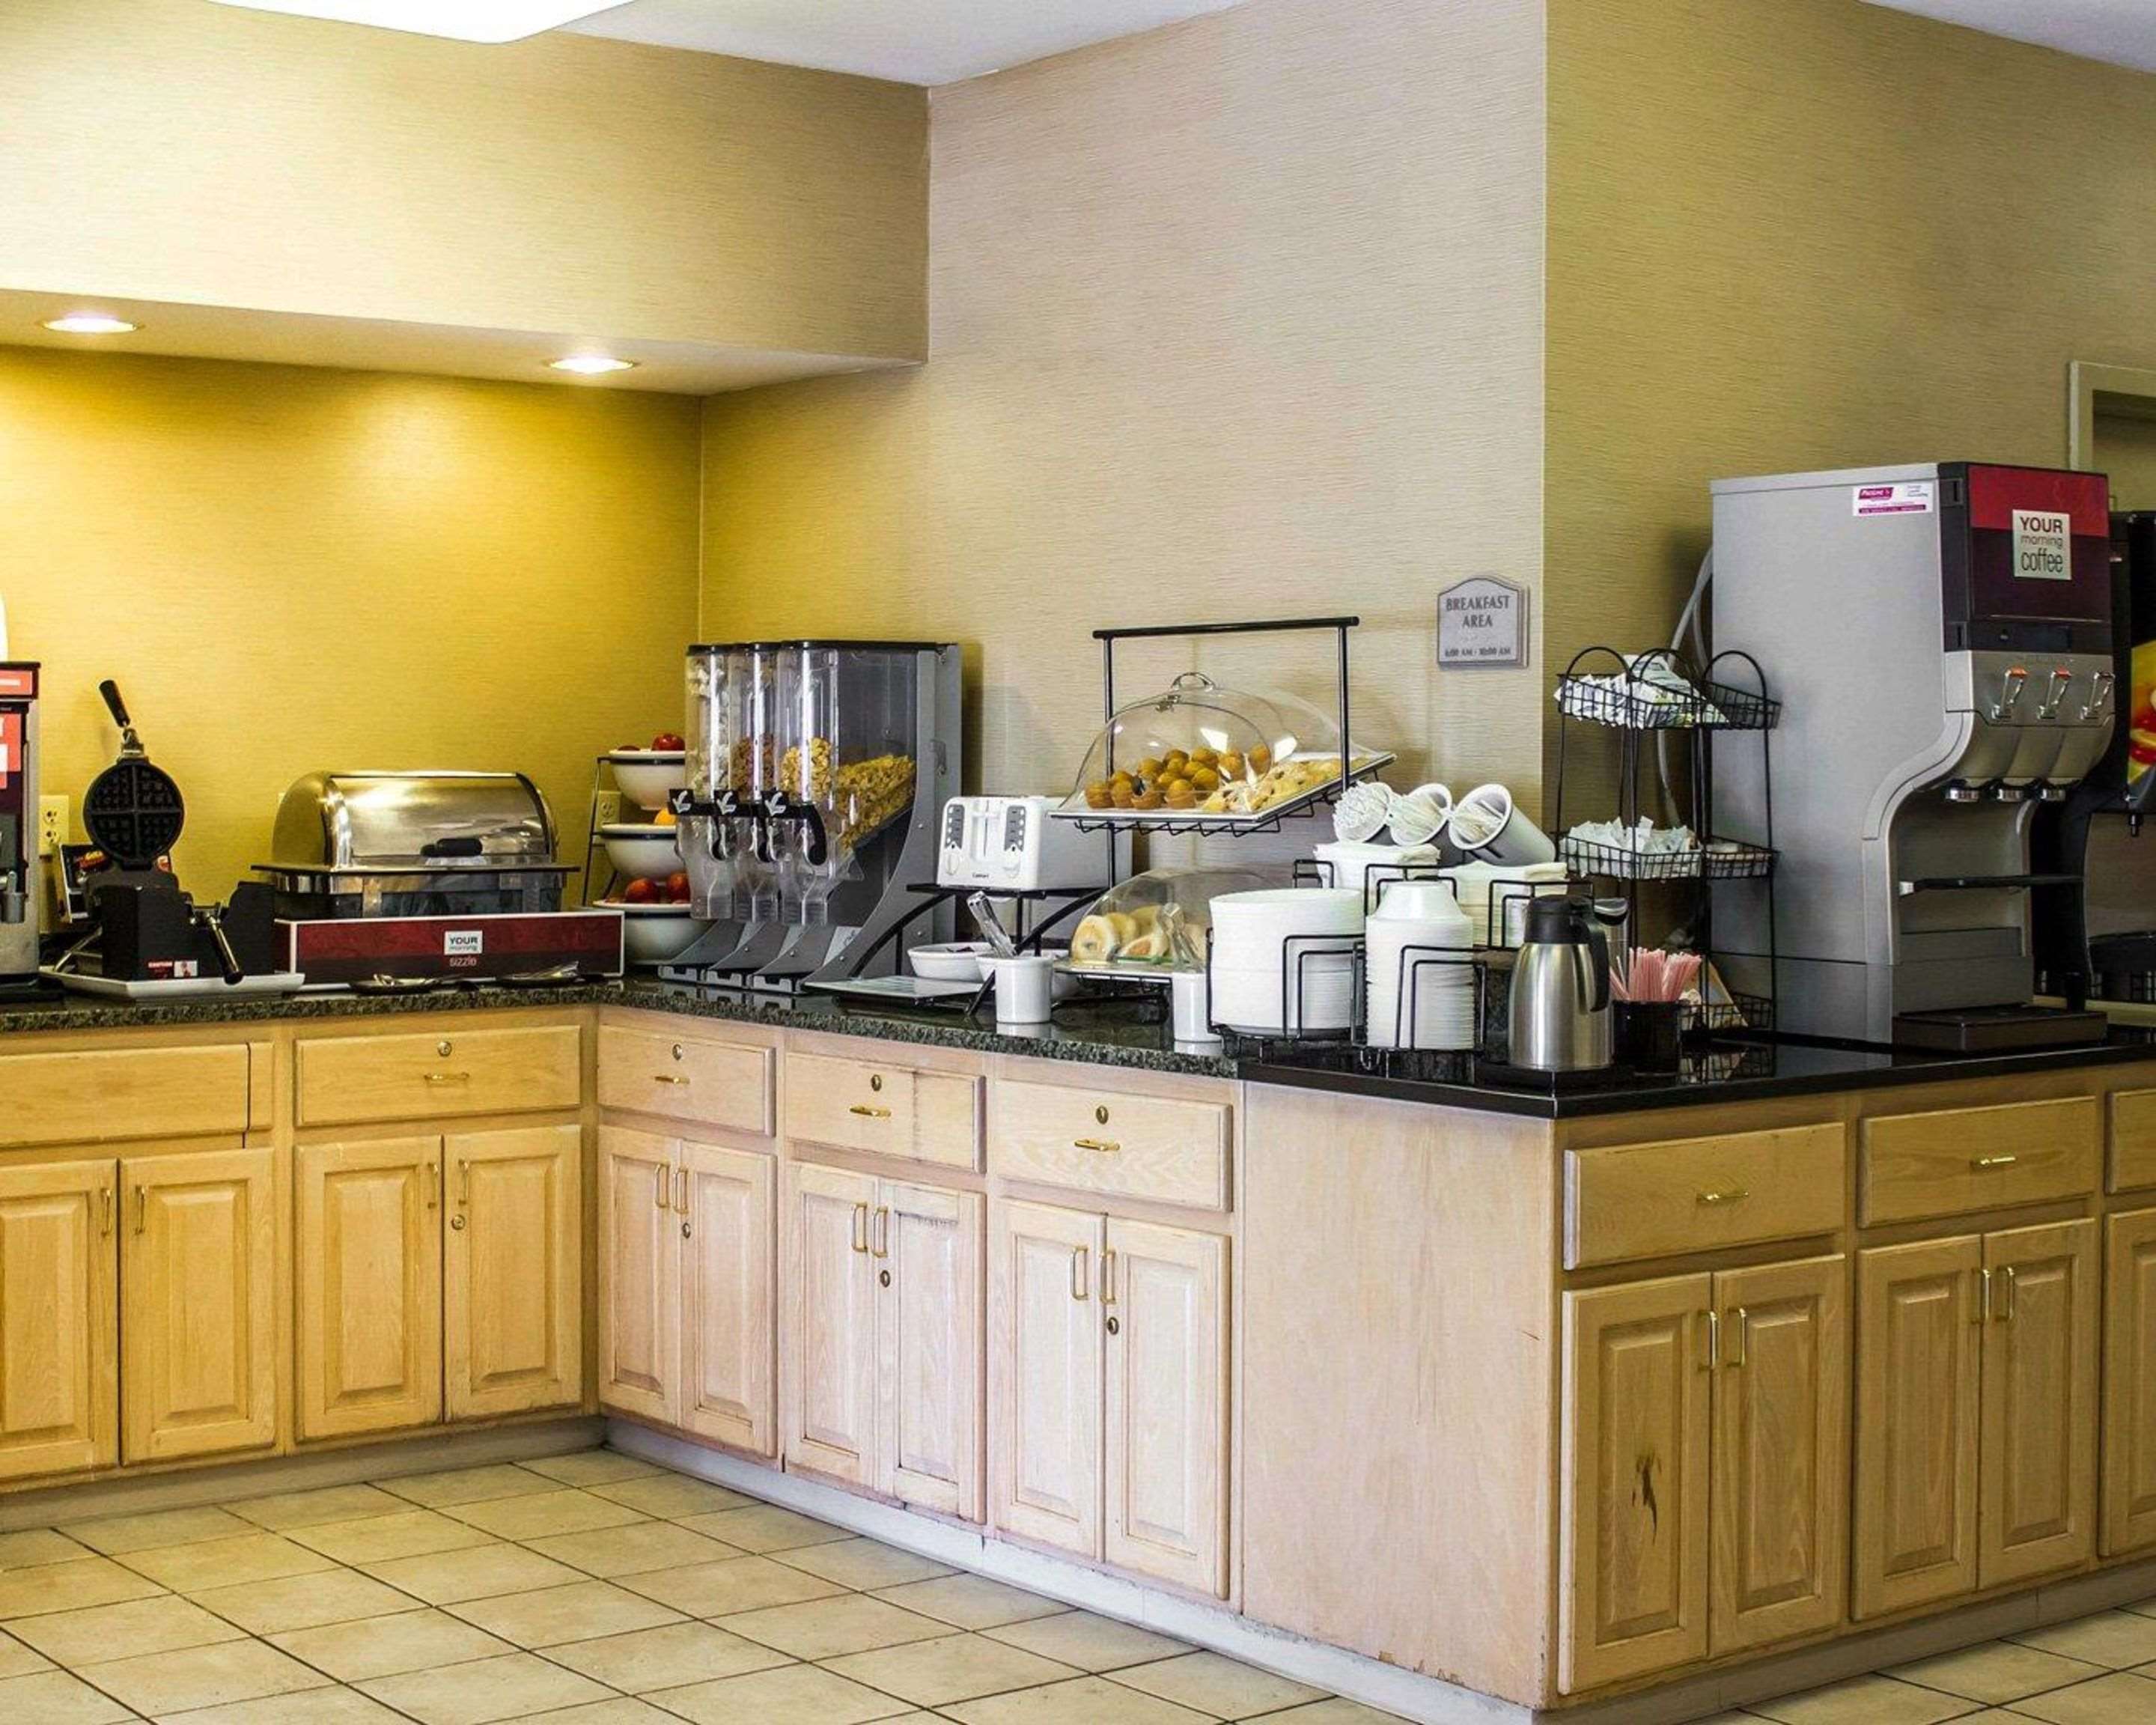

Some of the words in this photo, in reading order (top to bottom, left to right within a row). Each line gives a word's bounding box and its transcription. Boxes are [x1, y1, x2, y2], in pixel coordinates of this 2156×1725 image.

[2020, 517, 2063, 533] YOUR
[2021, 535, 2063, 550] morning
[2021, 547, 2063, 573] coffee
[1446, 595, 1511, 611] BREAKFAST
[1462, 615, 1493, 627] AREA
